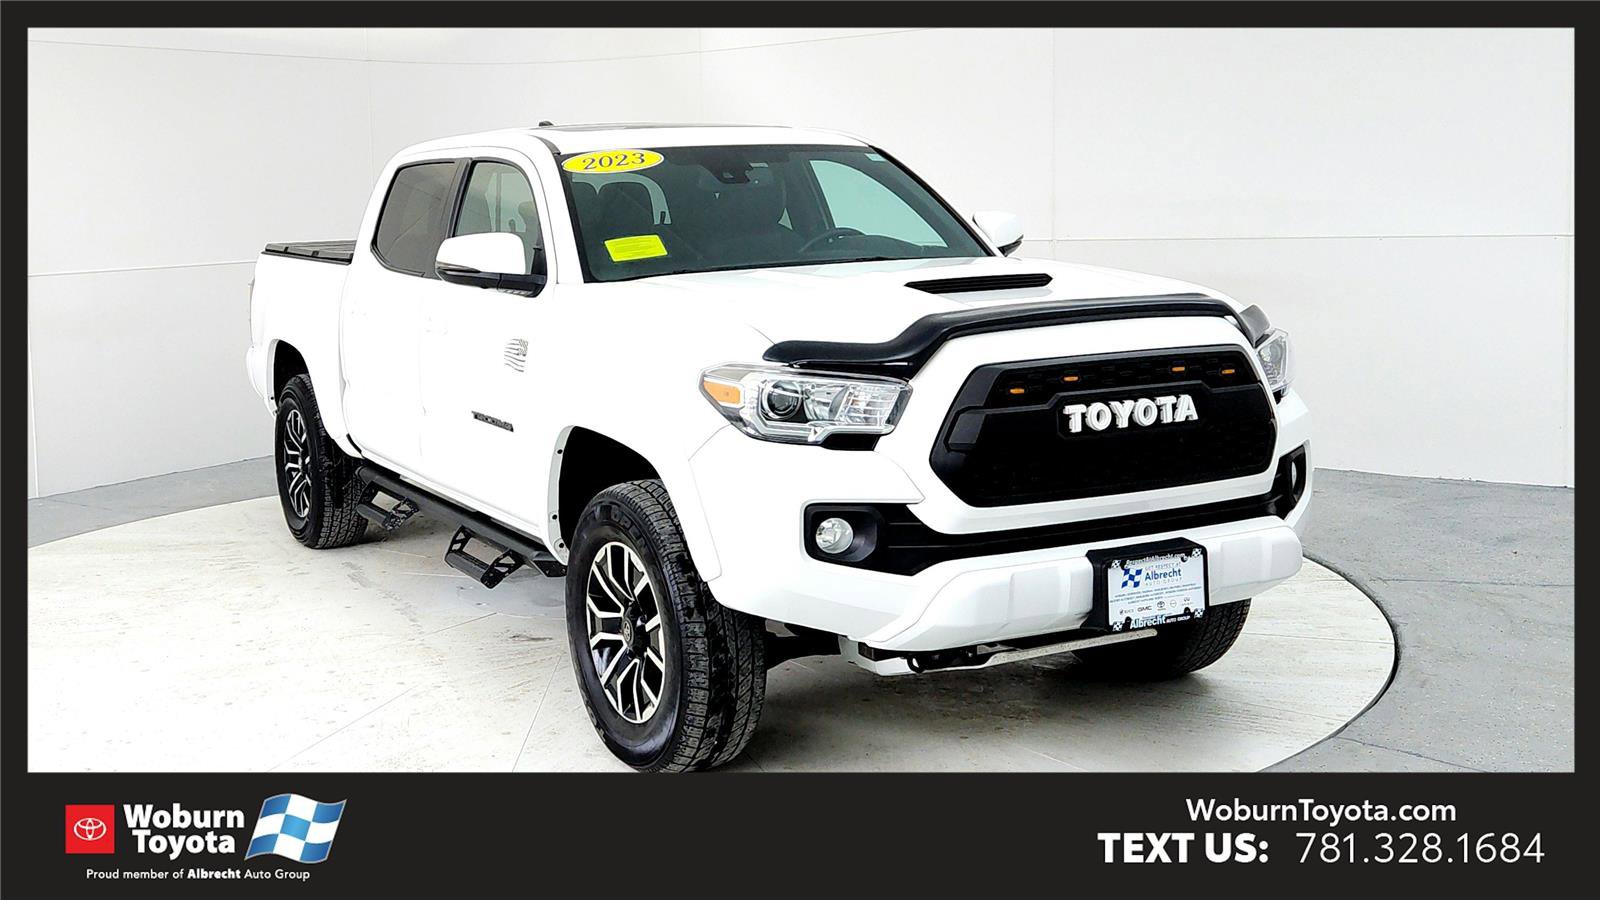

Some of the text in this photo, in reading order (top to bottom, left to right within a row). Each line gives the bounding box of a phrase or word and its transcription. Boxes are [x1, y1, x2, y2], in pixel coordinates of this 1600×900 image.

[582, 153, 645, 170] 2023
[1062, 394, 1199, 433] TOYOTA
[1145, 568, 1182, 581] Albrecht
[1130, 614, 1166, 630] Albrecht
